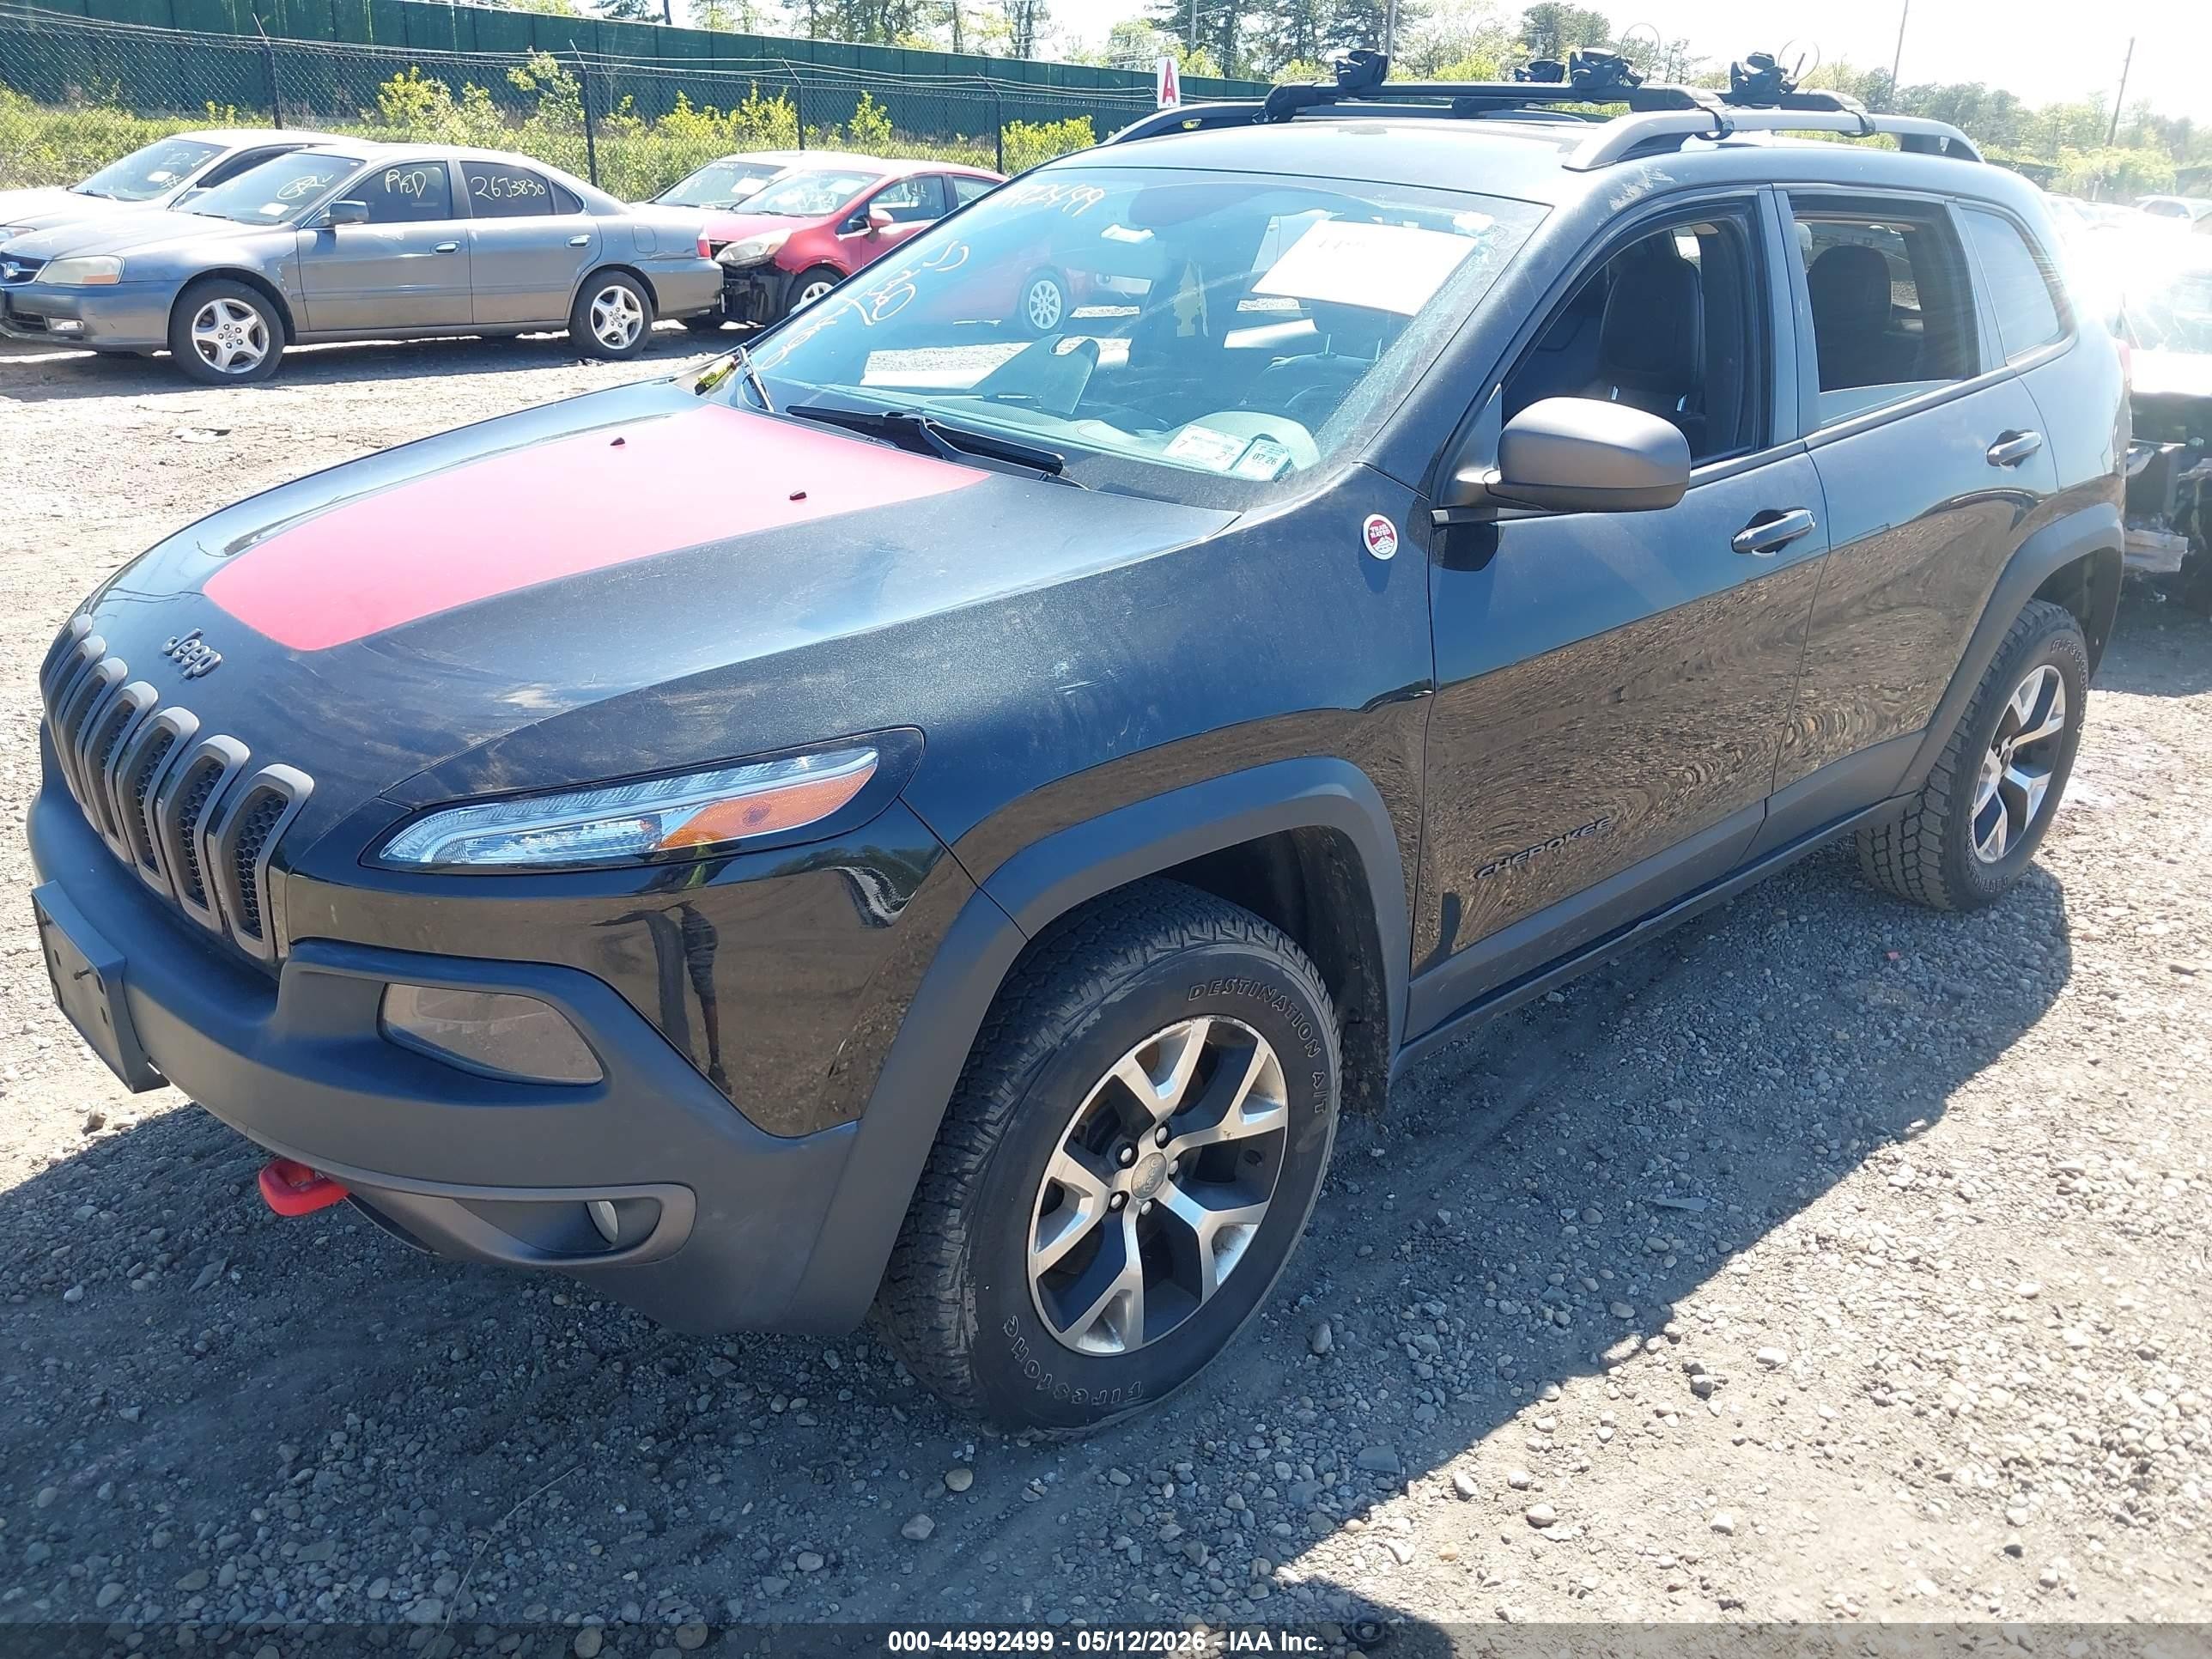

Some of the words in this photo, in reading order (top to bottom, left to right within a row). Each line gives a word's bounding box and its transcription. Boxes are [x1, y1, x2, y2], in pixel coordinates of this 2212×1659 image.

[1162, 58, 1176, 103] A
[161, 628, 222, 681] Jeep
[1473, 816, 1613, 880] CHEROKEE
[1187, 976, 1322, 1059] DESTINATION
[1311, 1071, 1328, 1115] A/T
